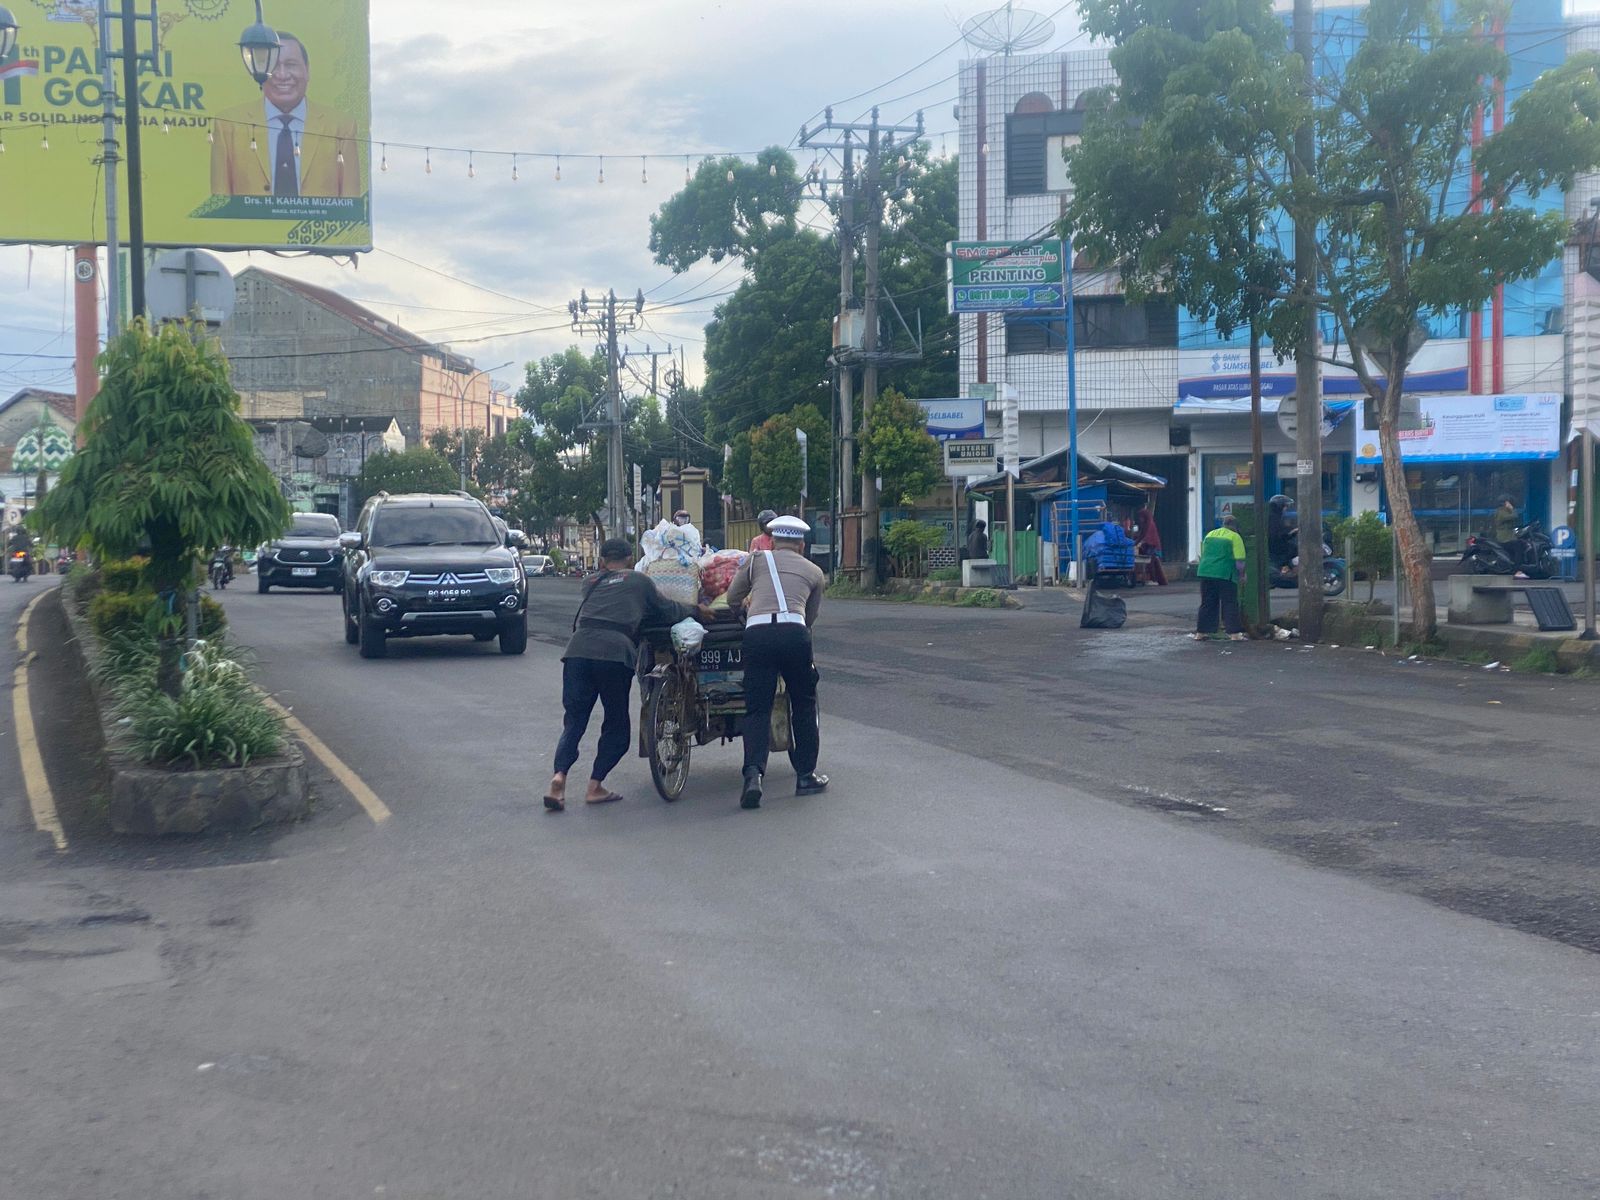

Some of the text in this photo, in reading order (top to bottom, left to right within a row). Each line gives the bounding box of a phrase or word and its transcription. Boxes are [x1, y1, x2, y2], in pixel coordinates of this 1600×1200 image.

[265, 197, 274, 205] H.
[276, 197, 309, 206] KAHAR
[311, 198, 353, 207] MUZAKIR
[969, 268, 1046, 282] PRINTING
[1223, 353, 1240, 361] BANK
[1557, 529, 1570, 545] P
[701, 649, 741, 664] 999 AJ
